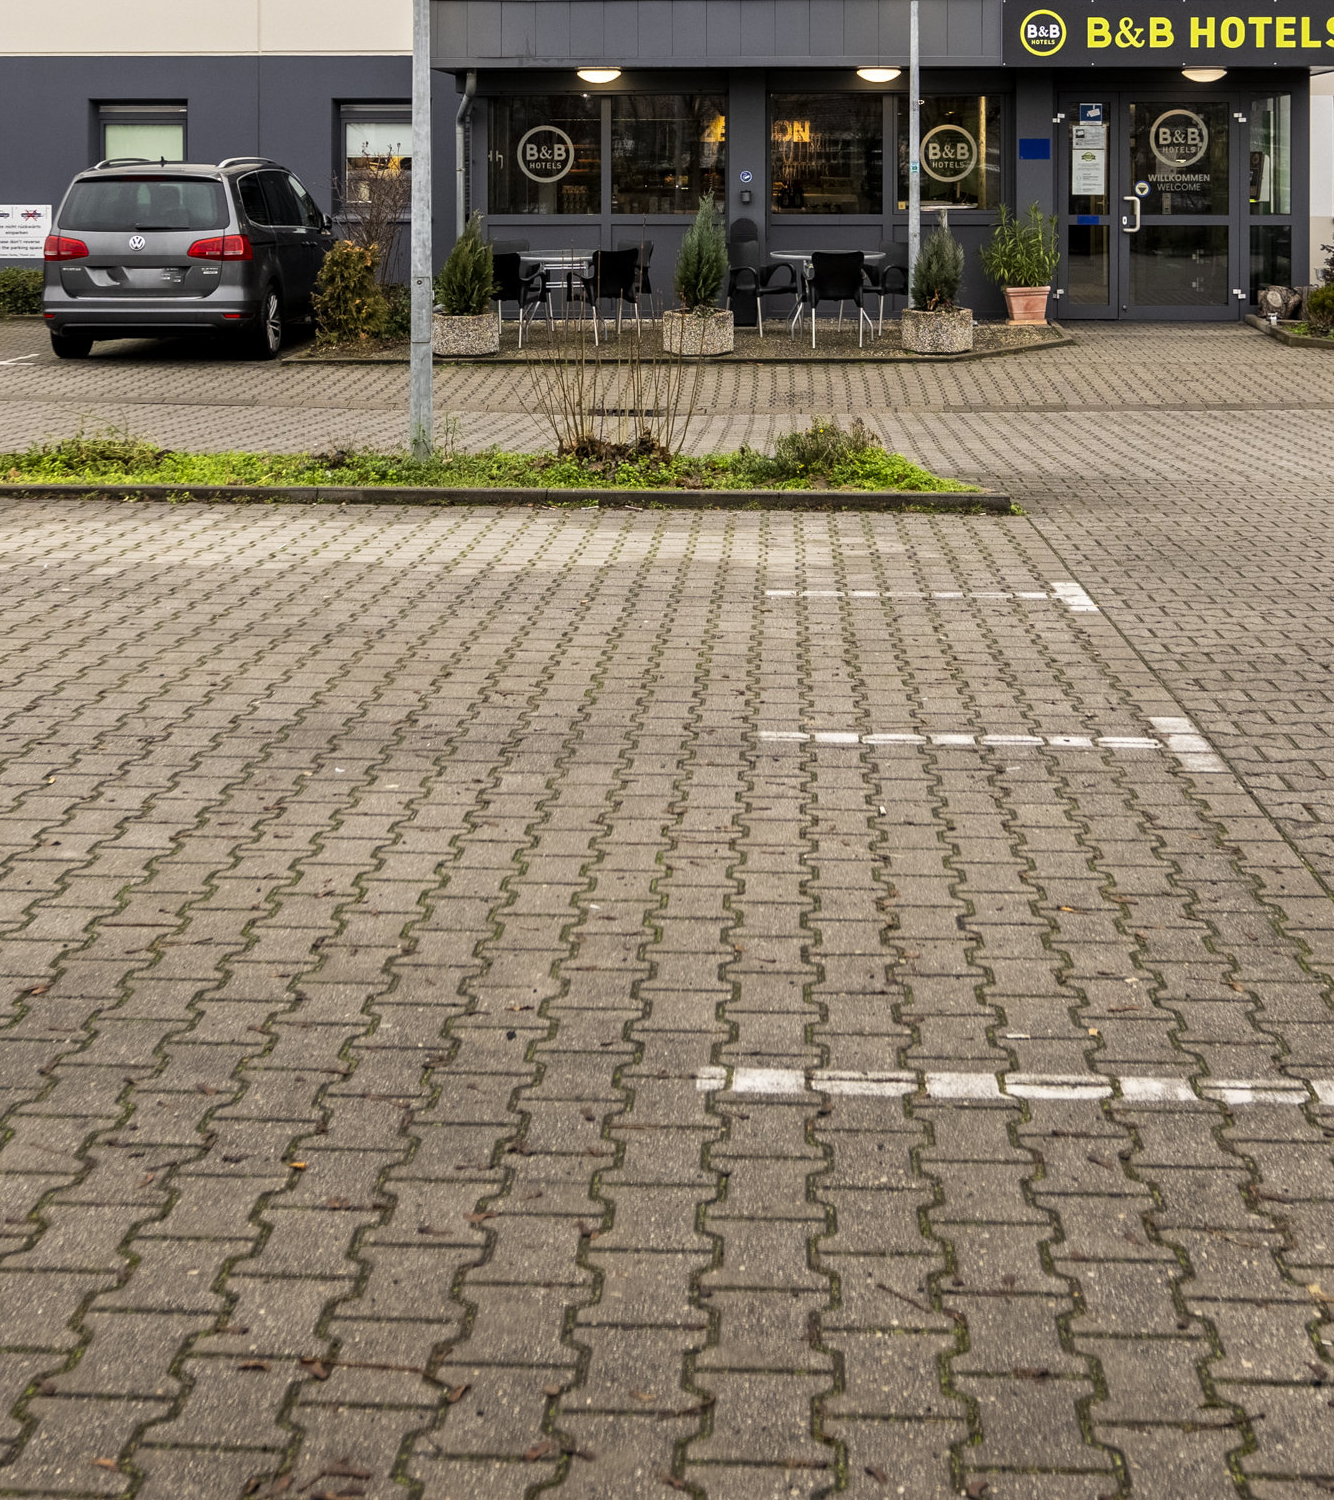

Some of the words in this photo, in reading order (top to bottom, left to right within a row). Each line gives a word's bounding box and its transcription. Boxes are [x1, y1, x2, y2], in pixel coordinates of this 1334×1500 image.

[1027, 24, 1060, 38] B&B
[1087, 16, 1175, 49] B&B
[1158, 127, 1201, 145] B&B
[526, 143, 567, 161] B&B
[928, 142, 970, 160] B&B
[1148, 174, 1211, 182] WILLKOMMEN
[1157, 183, 1201, 191] WELCOME
